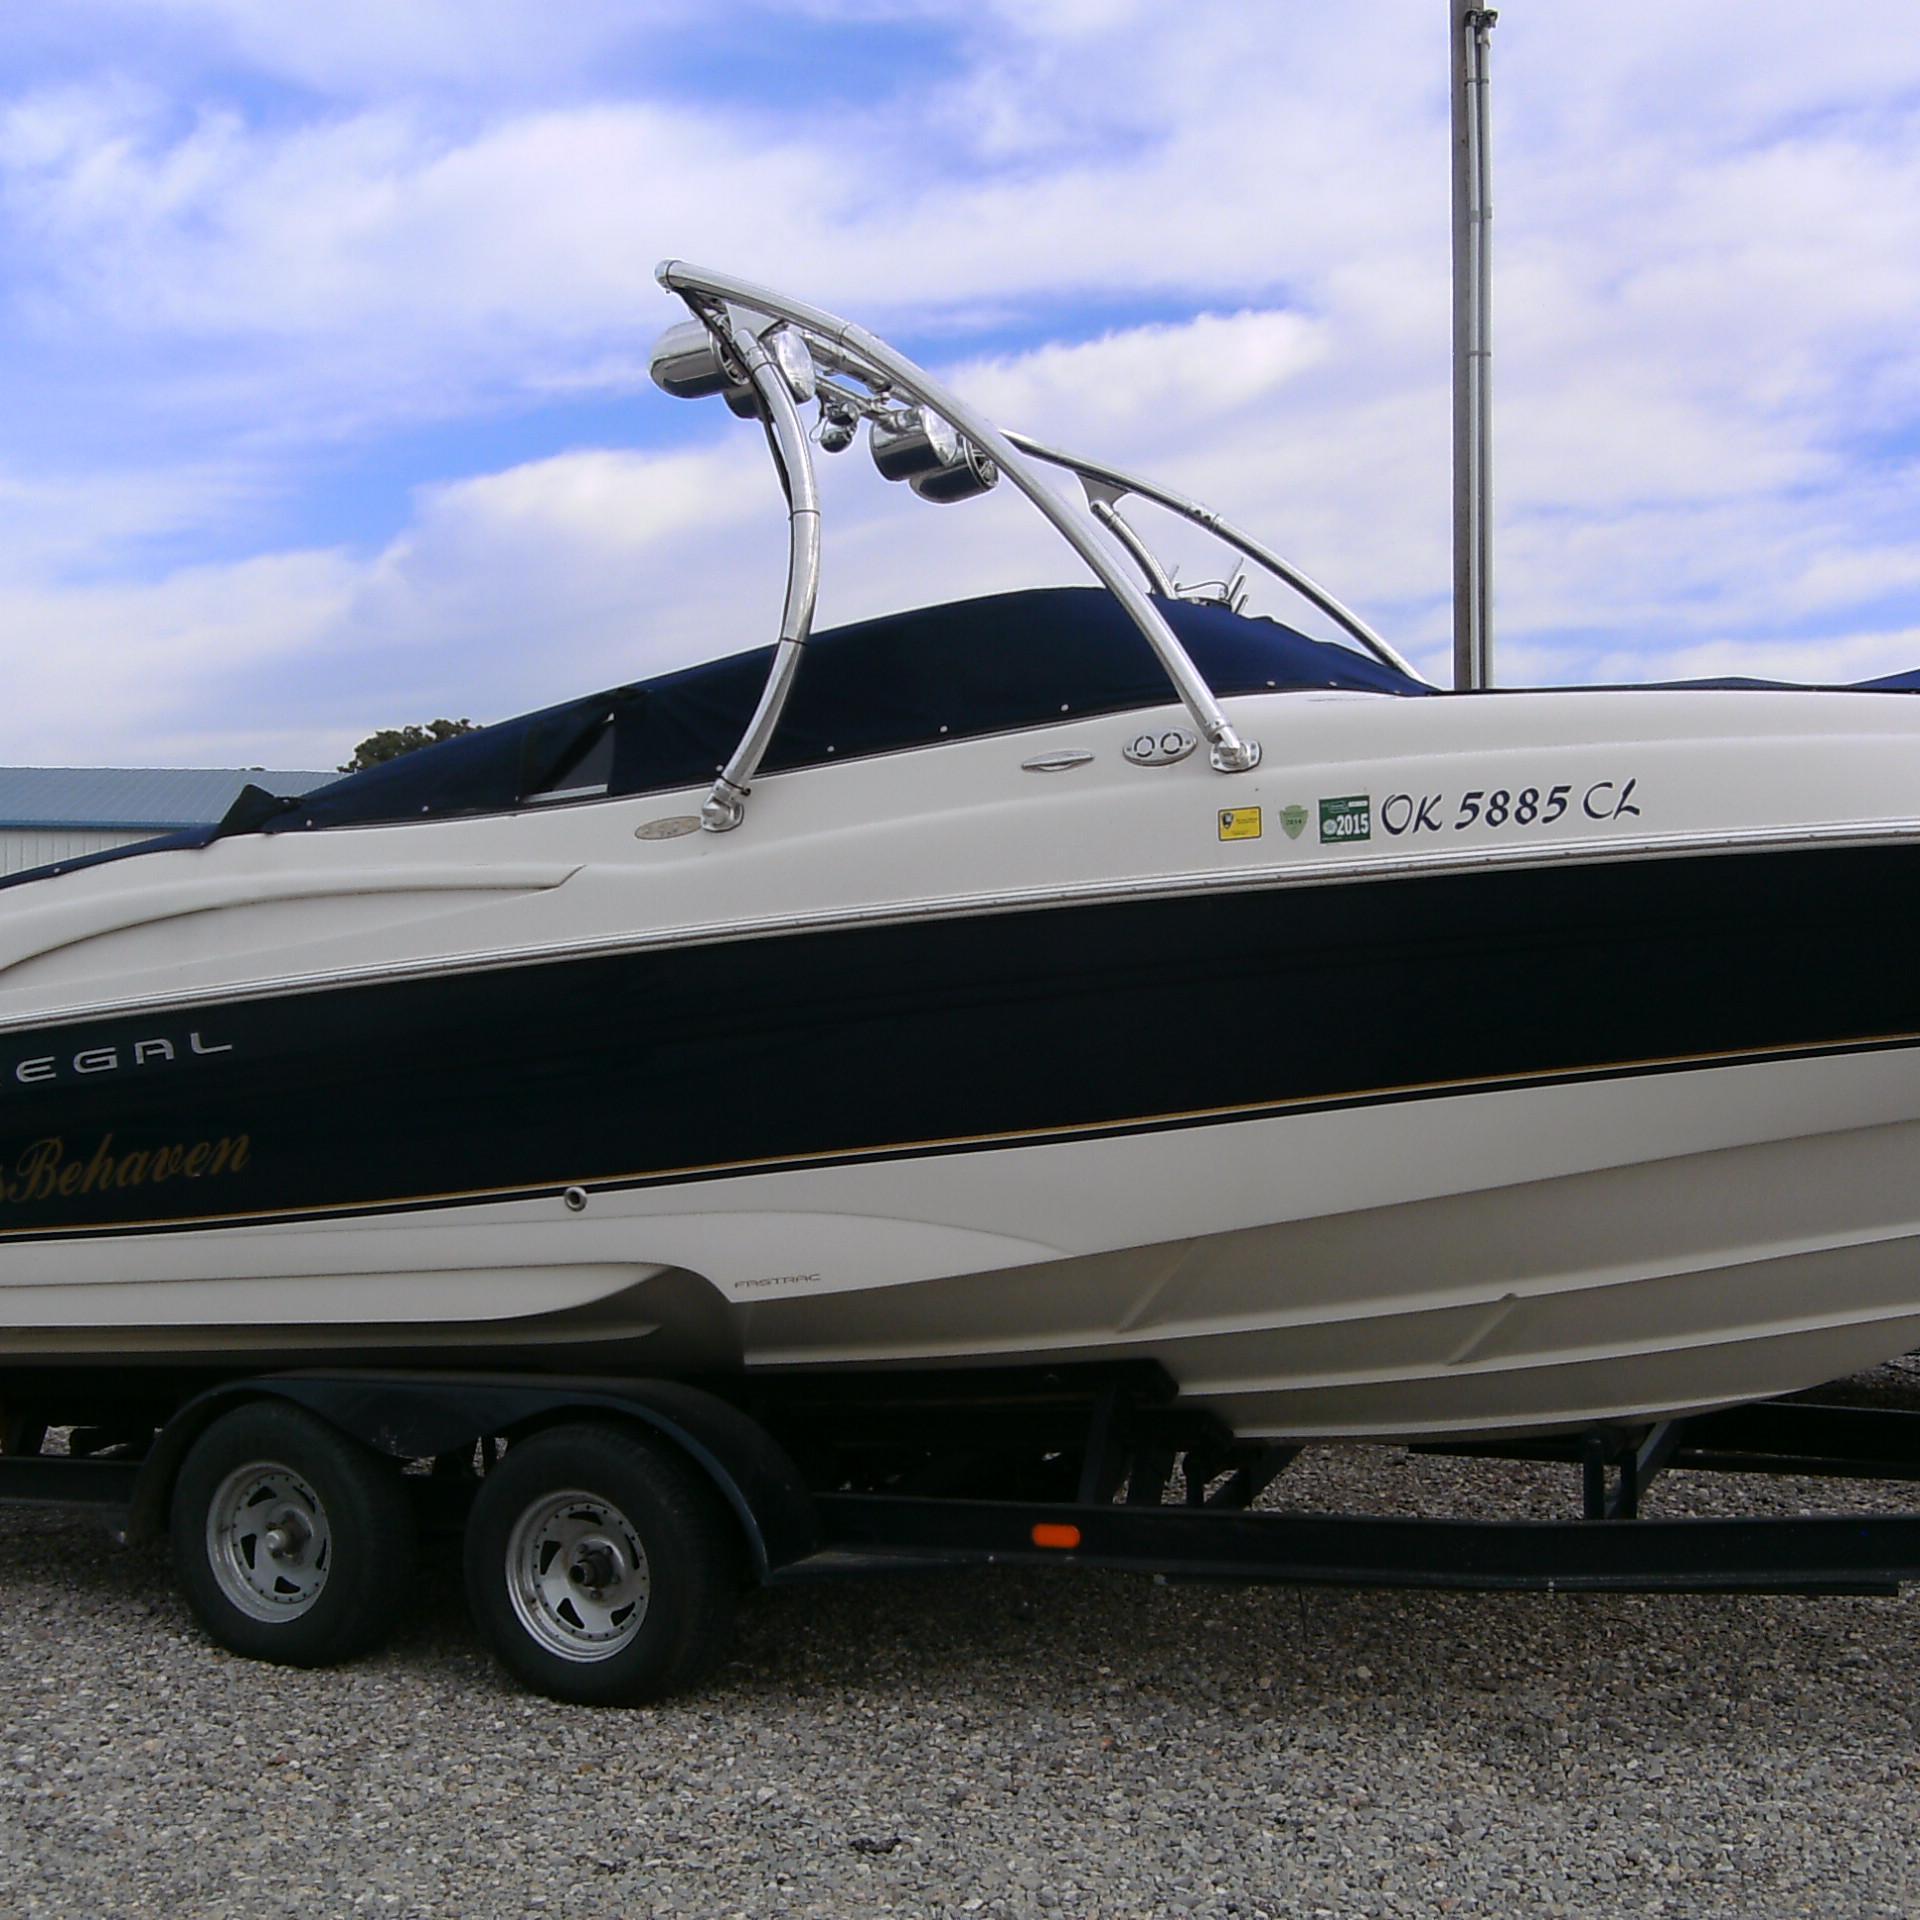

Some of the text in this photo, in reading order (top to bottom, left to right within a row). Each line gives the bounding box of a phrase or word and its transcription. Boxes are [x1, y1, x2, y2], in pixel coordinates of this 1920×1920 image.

[1381, 777, 1641, 836] OK 5885 CL
[1336, 813, 1369, 836] 2015
[734, 1273, 821, 1289] FASTRAC
